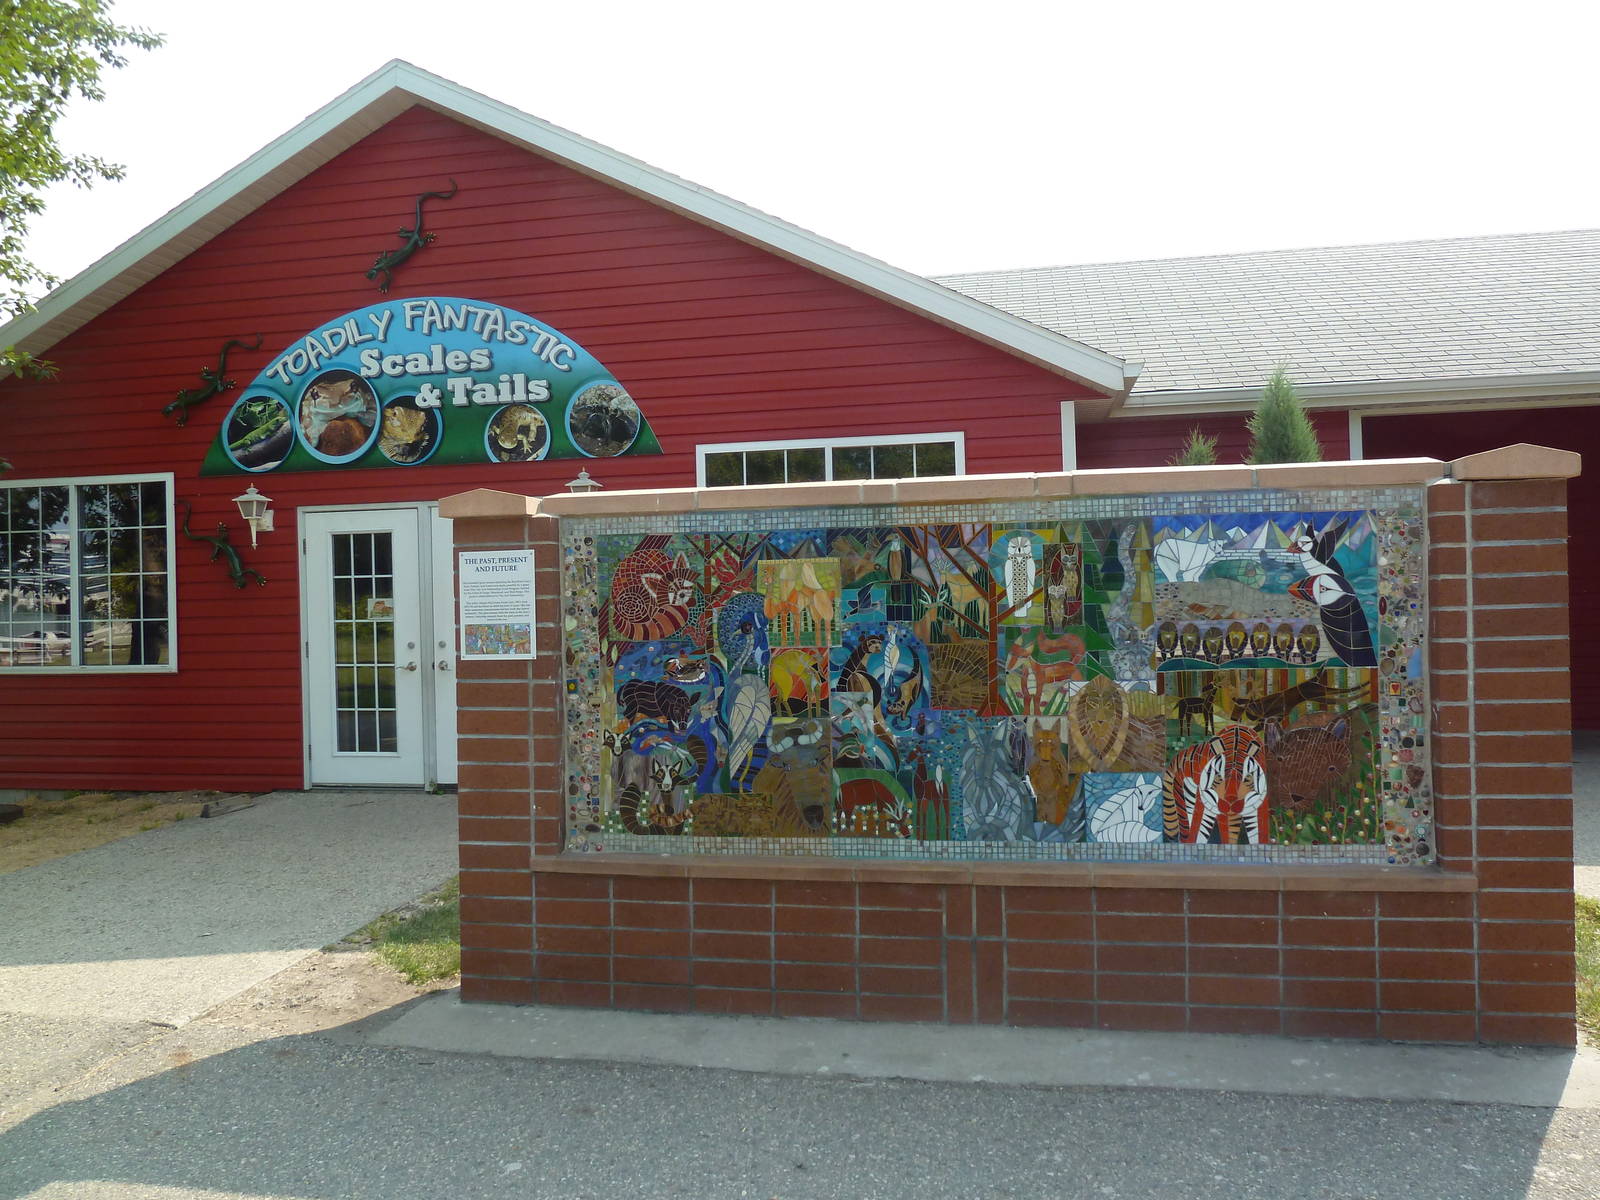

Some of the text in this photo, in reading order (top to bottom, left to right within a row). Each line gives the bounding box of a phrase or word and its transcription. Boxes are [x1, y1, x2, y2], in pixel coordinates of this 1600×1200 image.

[266, 299, 576, 385] TOADILY FANTASTIC
[359, 343, 493, 379] Scales
[414, 374, 551, 409] & Tails
[479, 557, 497, 565] PAST,
[498, 556, 528, 564] PRESENT
